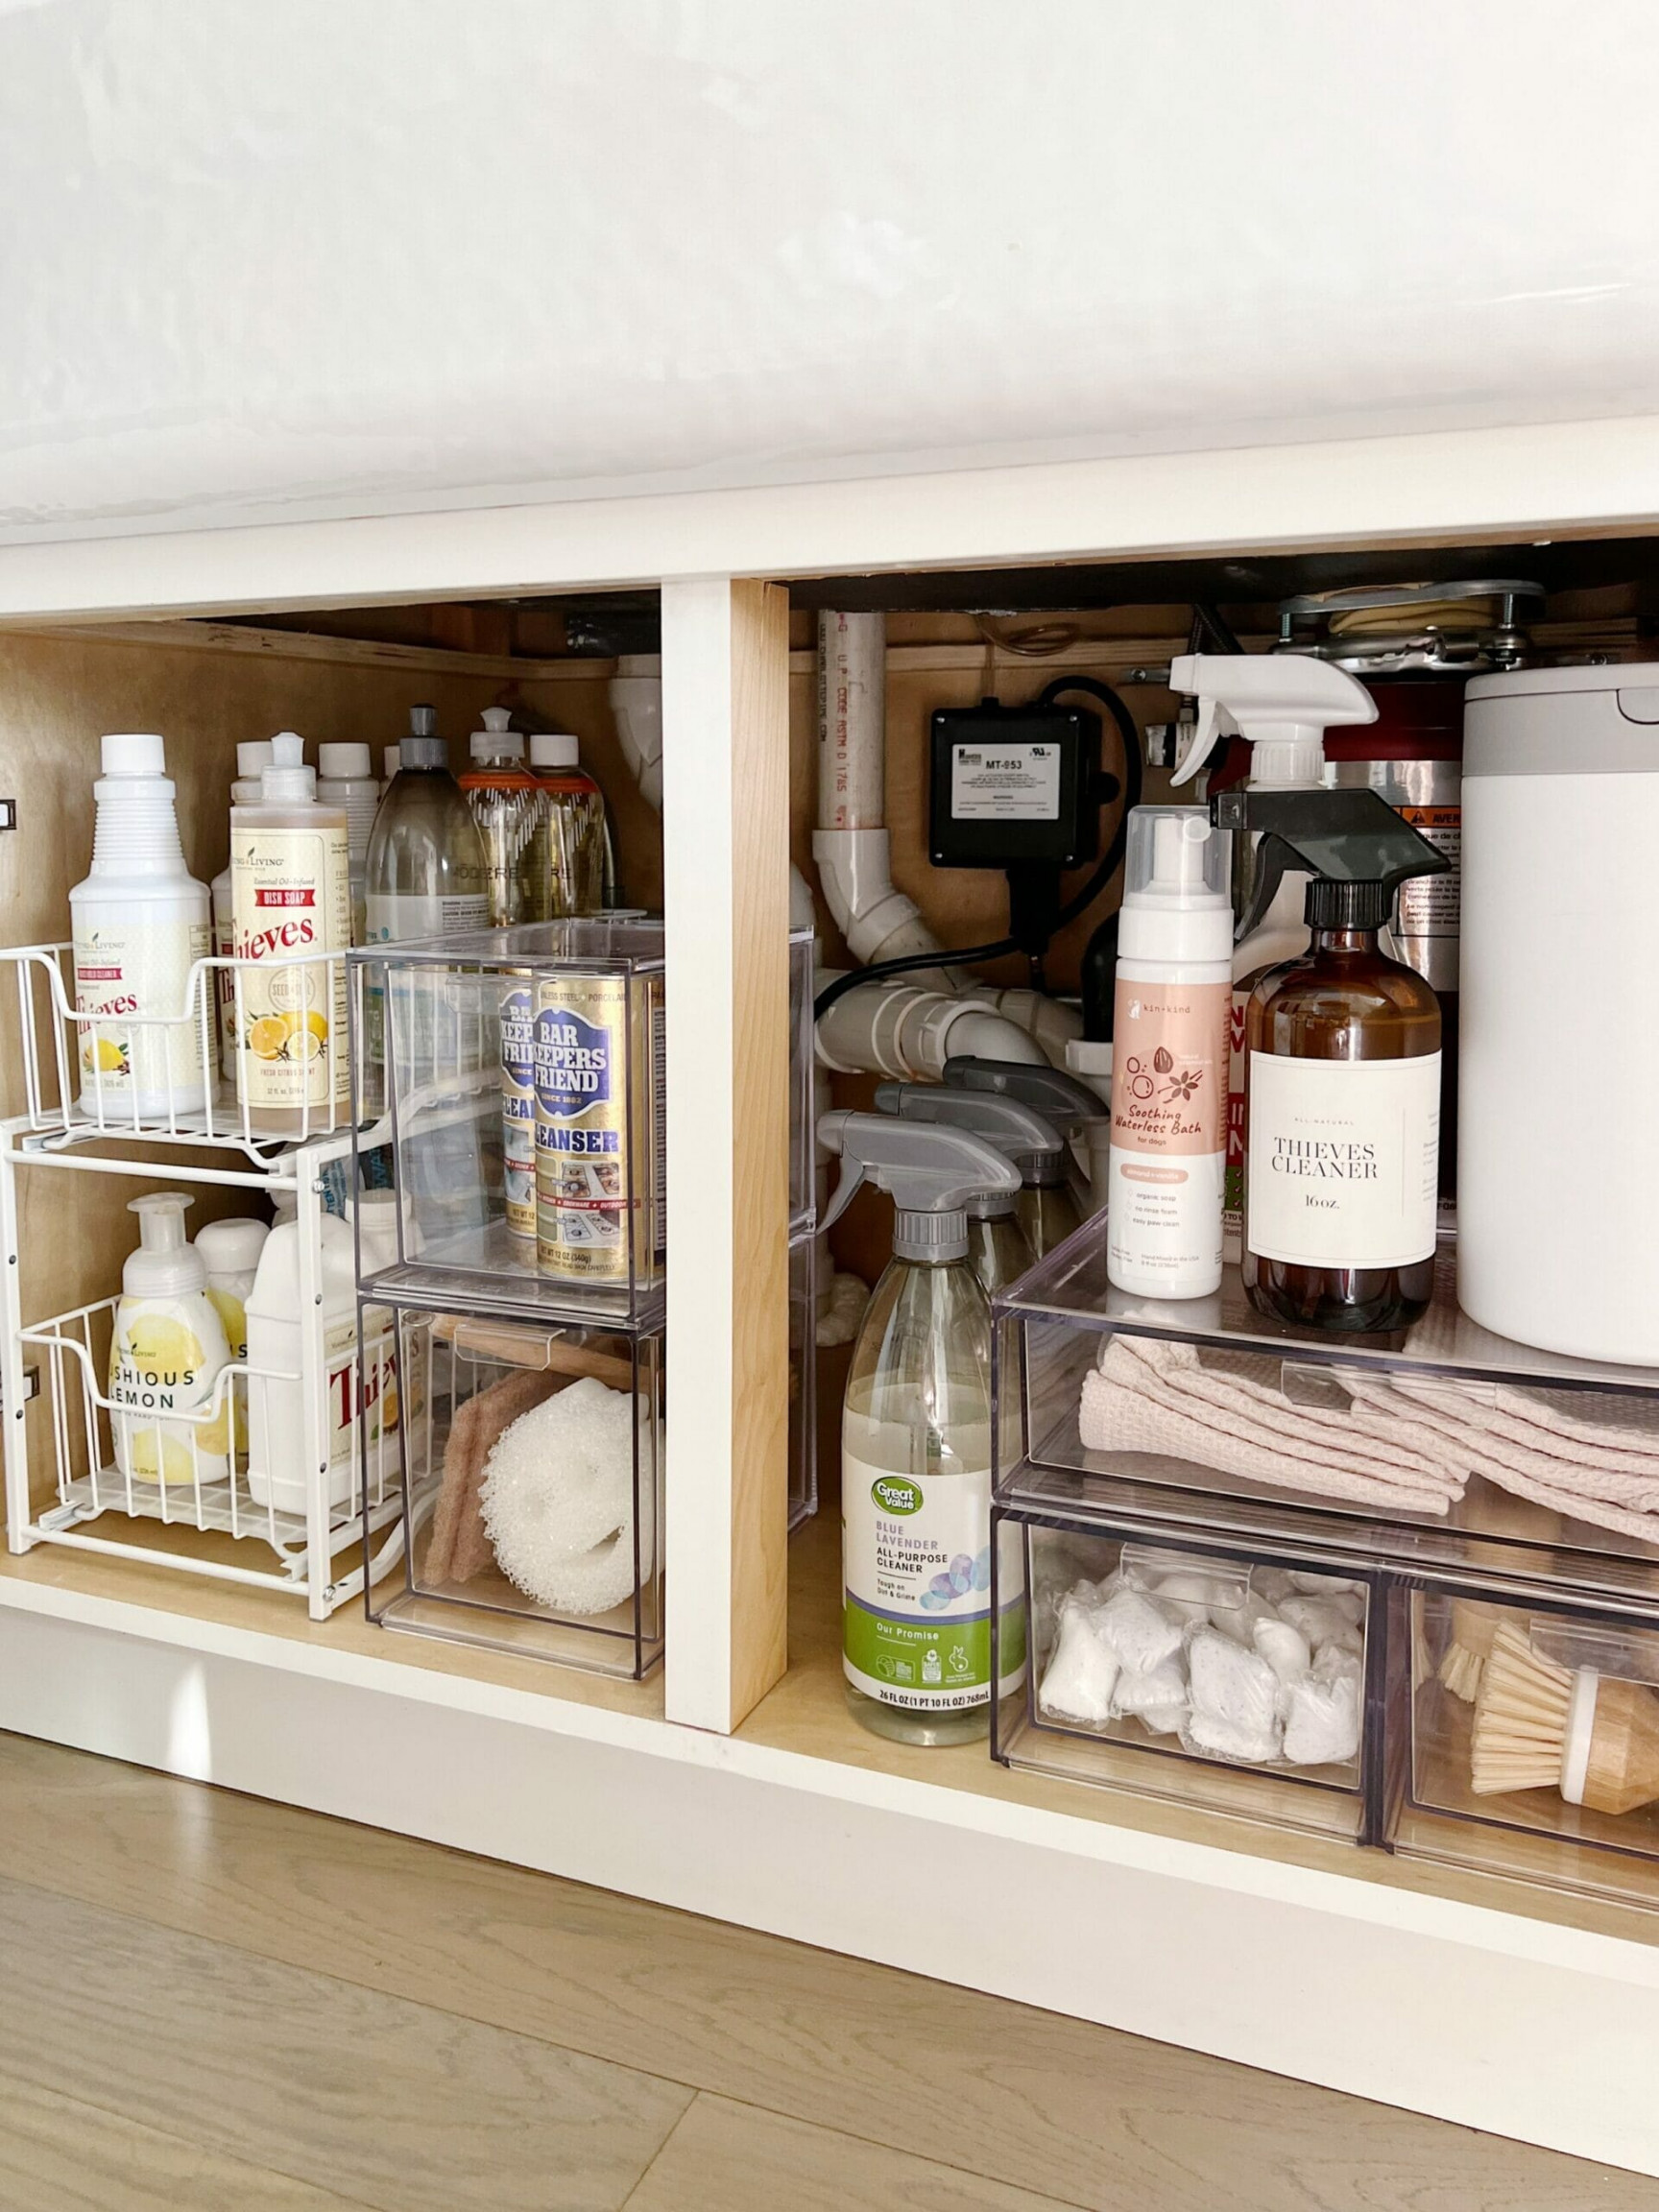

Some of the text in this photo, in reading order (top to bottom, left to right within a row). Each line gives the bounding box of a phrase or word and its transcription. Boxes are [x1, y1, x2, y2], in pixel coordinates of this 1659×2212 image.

[836, 719, 848, 747] ASTM
[835, 766, 847, 792] 1785
[264, 891, 305, 904] DISH SOAP
[501, 1019, 533, 1041] KEEP
[540, 1022, 579, 1047] BAR
[535, 1063, 599, 1093] FRIEND
[1129, 1104, 1182, 1120] Soothing
[1115, 1115, 1202, 1135] Waterless Bath
[536, 1122, 619, 1153] LEANSER
[1150, 1137, 1166, 1146] dogs
[1274, 1137, 1375, 1161] THIEVES
[1271, 1155, 1378, 1179] CLEANER
[1306, 1194, 1340, 1210] 16 oz.
[877, 1481, 914, 1502] Great
[885, 1496, 914, 1510] Value
[876, 1520, 904, 1536] BLUE
[876, 1532, 939, 1551] LAVENDER
[877, 1547, 949, 1563] ALL-PURPOSE
[877, 1557, 924, 1574] CLEANER
[878, 1578, 895, 1590] Tough
[878, 1586, 888, 1596] Dirt
[896, 1592, 916, 1601] Grime
[877, 1623, 940, 1641] Our Promise
[879, 1690, 889, 1700] 26
[889, 1693, 898, 1702] FL
[899, 1694, 908, 1705] OZ
[910, 1695, 917, 1707] (1
[919, 1695, 928, 1707] PT
[931, 1695, 941, 1708] 10
[942, 1695, 950, 1707] FL
[952, 1694, 965, 1707] OZ)
